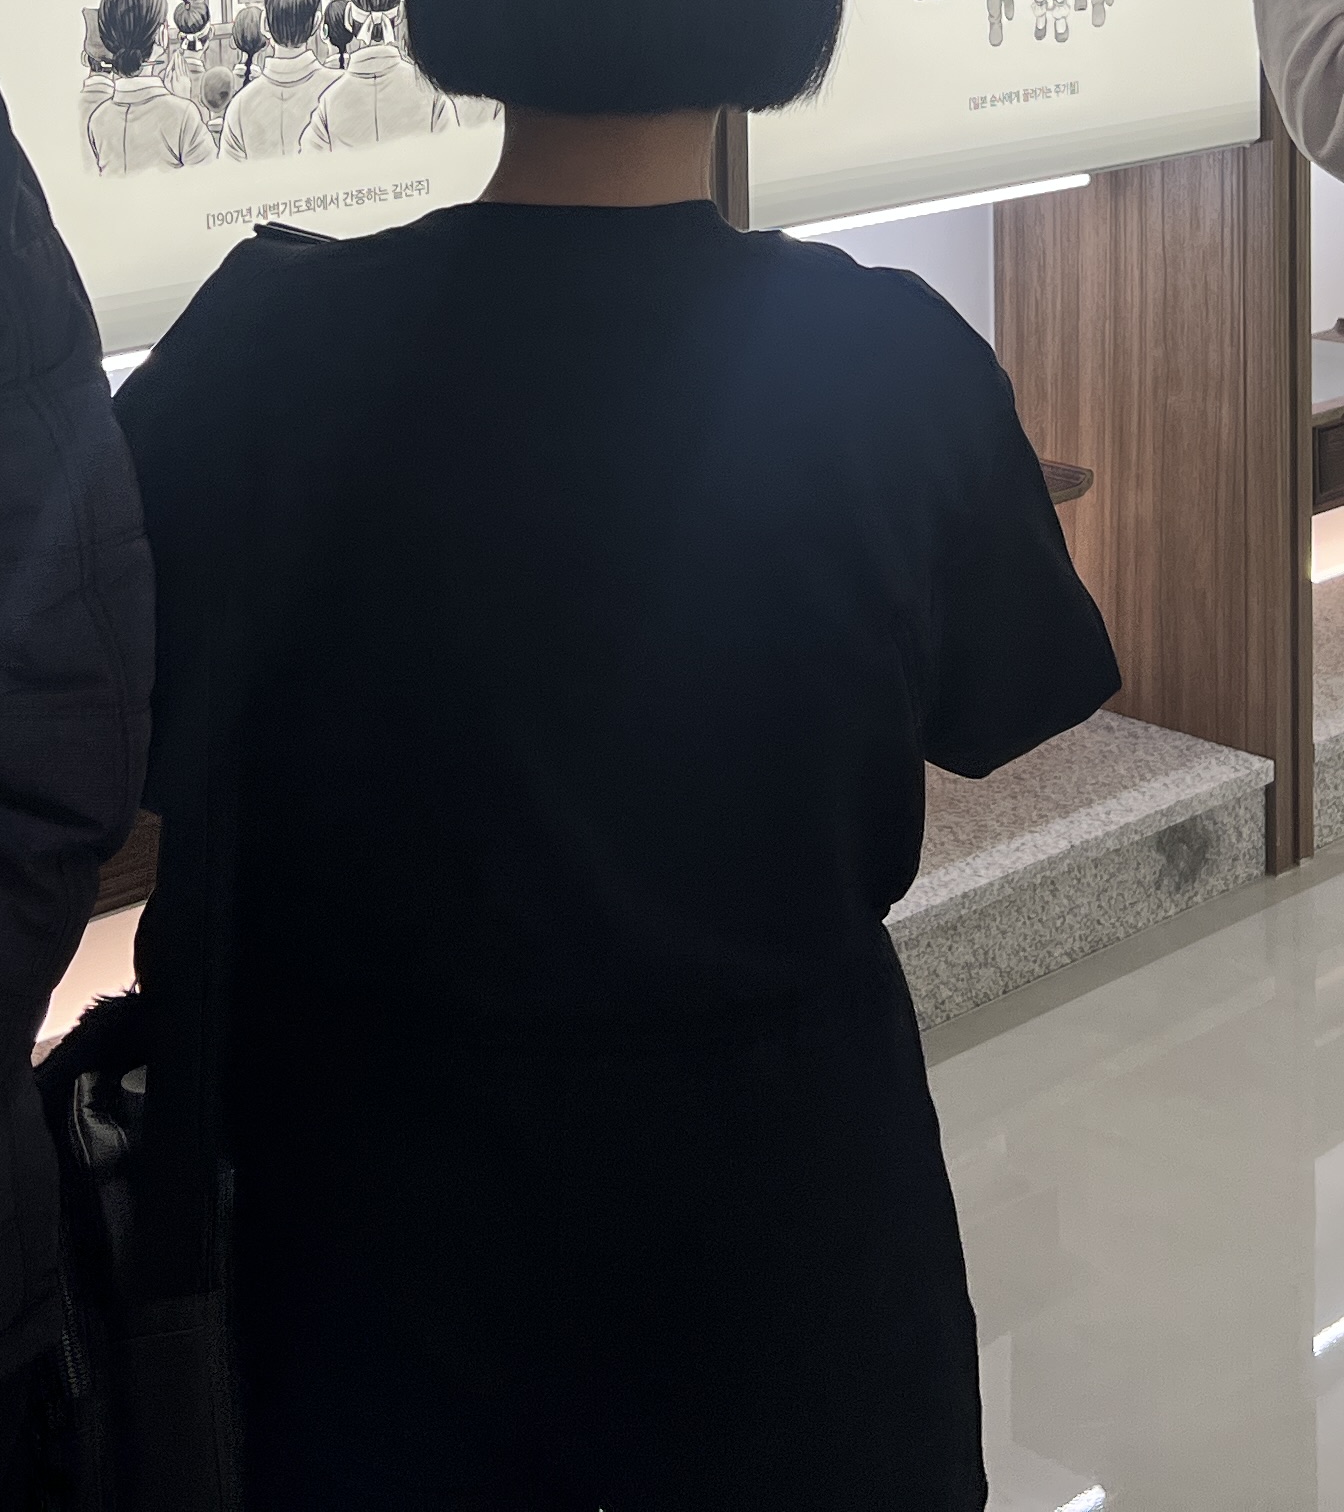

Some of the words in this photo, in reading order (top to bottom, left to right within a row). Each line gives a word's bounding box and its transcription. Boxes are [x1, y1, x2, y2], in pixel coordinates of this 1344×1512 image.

[206, 207, 253, 230] [1907년
[256, 192, 340, 220] 새벽기도회에서
[342, 186, 389, 208] 간증하는
[391, 179, 431, 200] 길선주]
